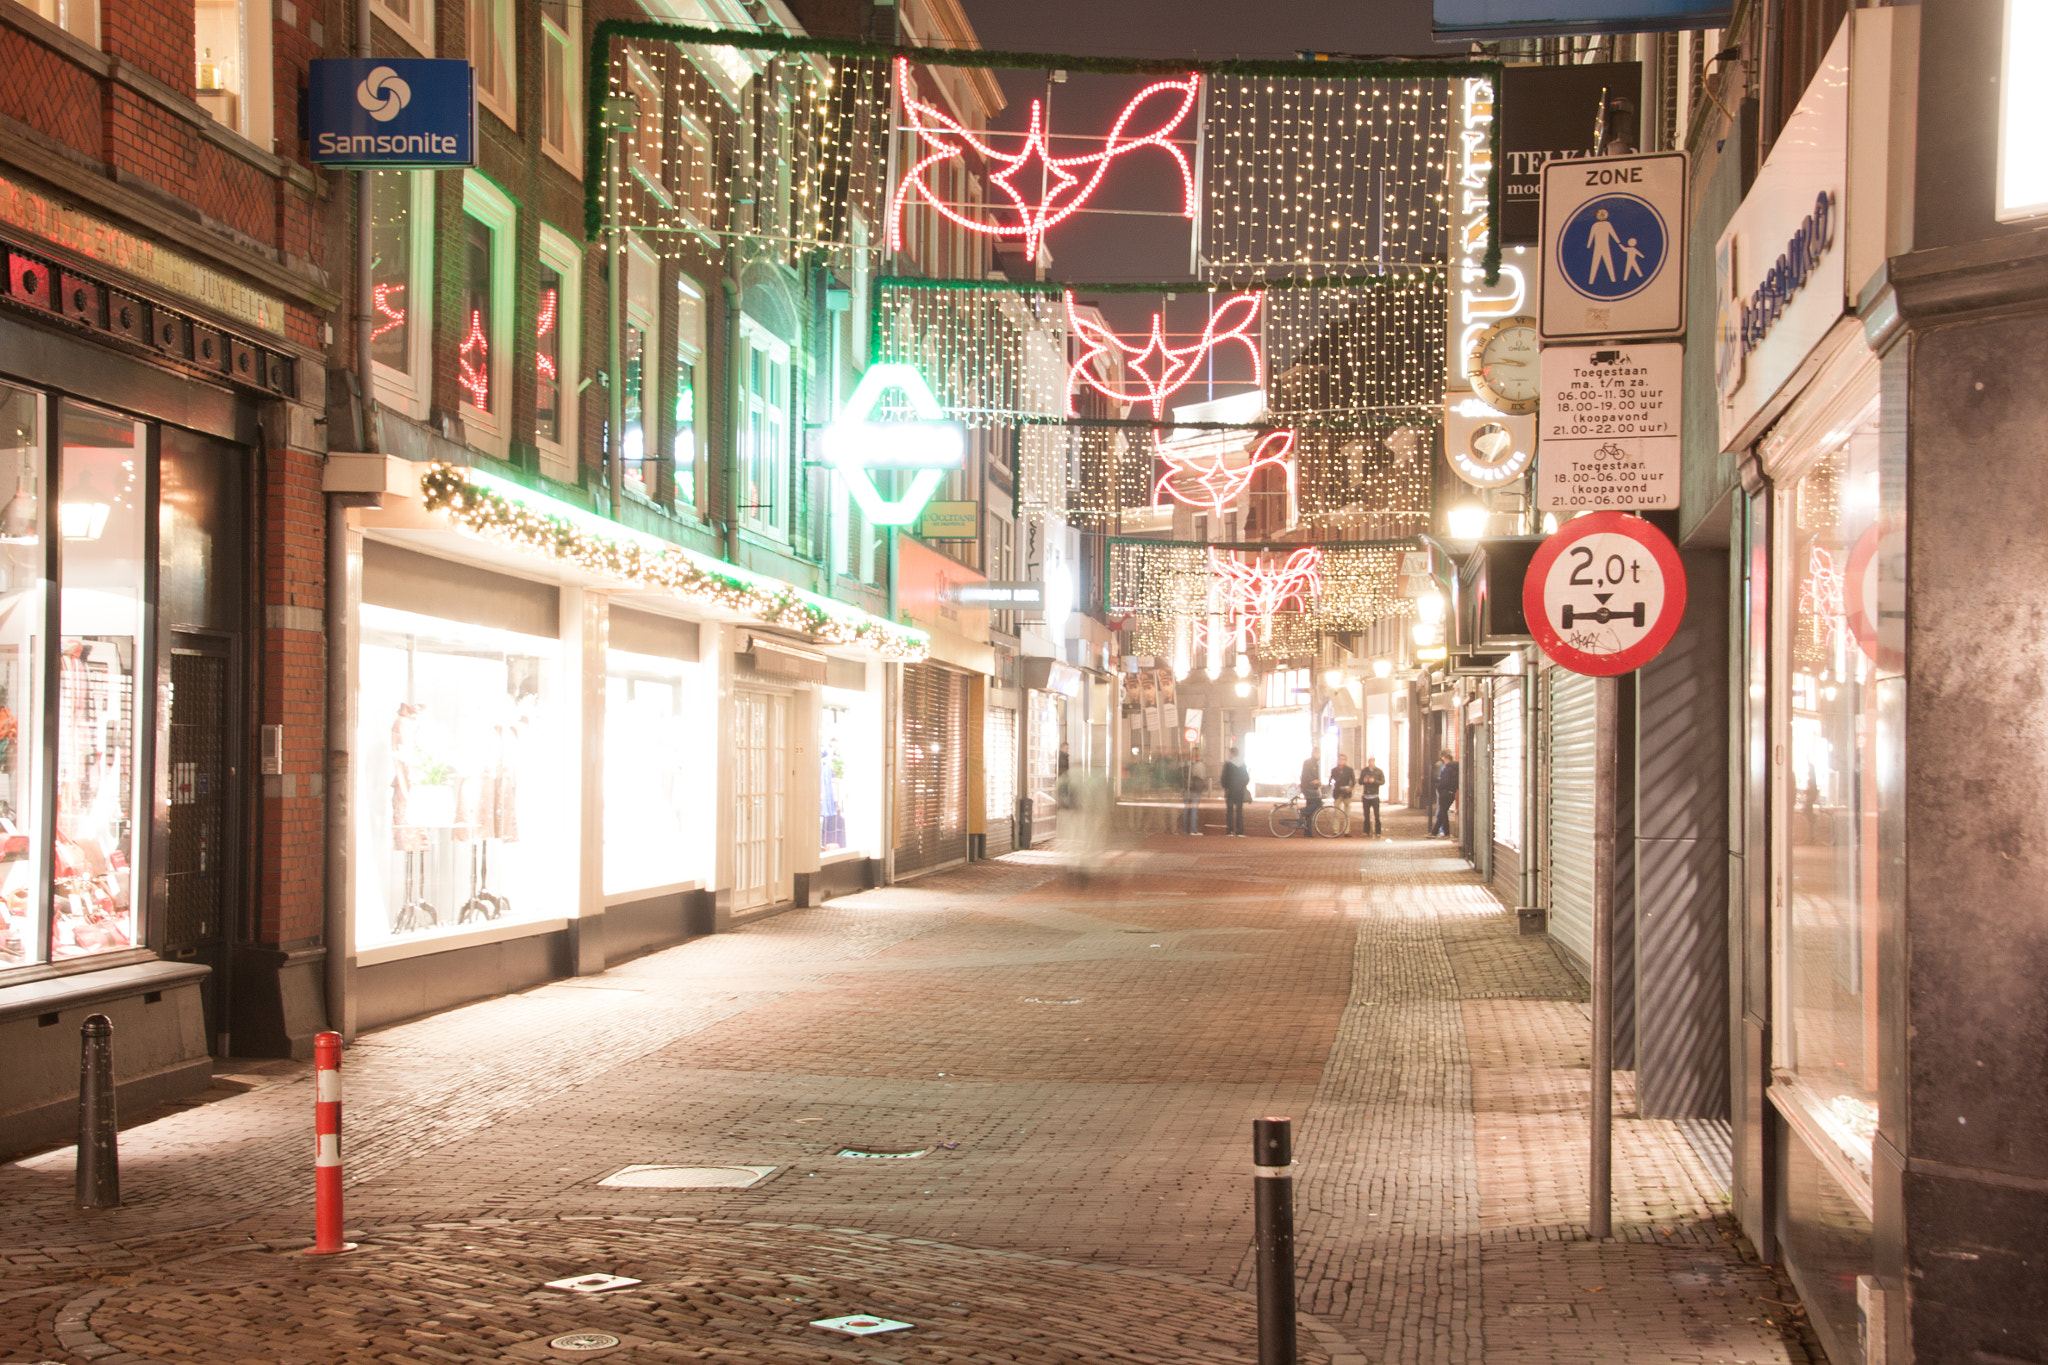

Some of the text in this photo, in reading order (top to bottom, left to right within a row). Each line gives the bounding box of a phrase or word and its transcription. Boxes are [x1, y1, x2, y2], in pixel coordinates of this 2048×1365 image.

[318, 132, 457, 154] Samsonite
[1585, 167, 1643, 186] ZONE
[95, 228, 154, 274] ZILVER
[201, 274, 274, 324] JUWEELEN
[1573, 367, 1648, 379] Toegestaan
[1571, 378, 1649, 389] ma. t/m za.
[1640, 389, 1663, 398] uur
[1640, 400, 1663, 409] uur
[1573, 412, 1648, 424] (koopavond
[1639, 422, 1668, 433] uur)
[1641, 472, 1664, 481] uur
[1572, 483, 1647, 495] (koopavond
[1638, 494, 1667, 505] uur)
